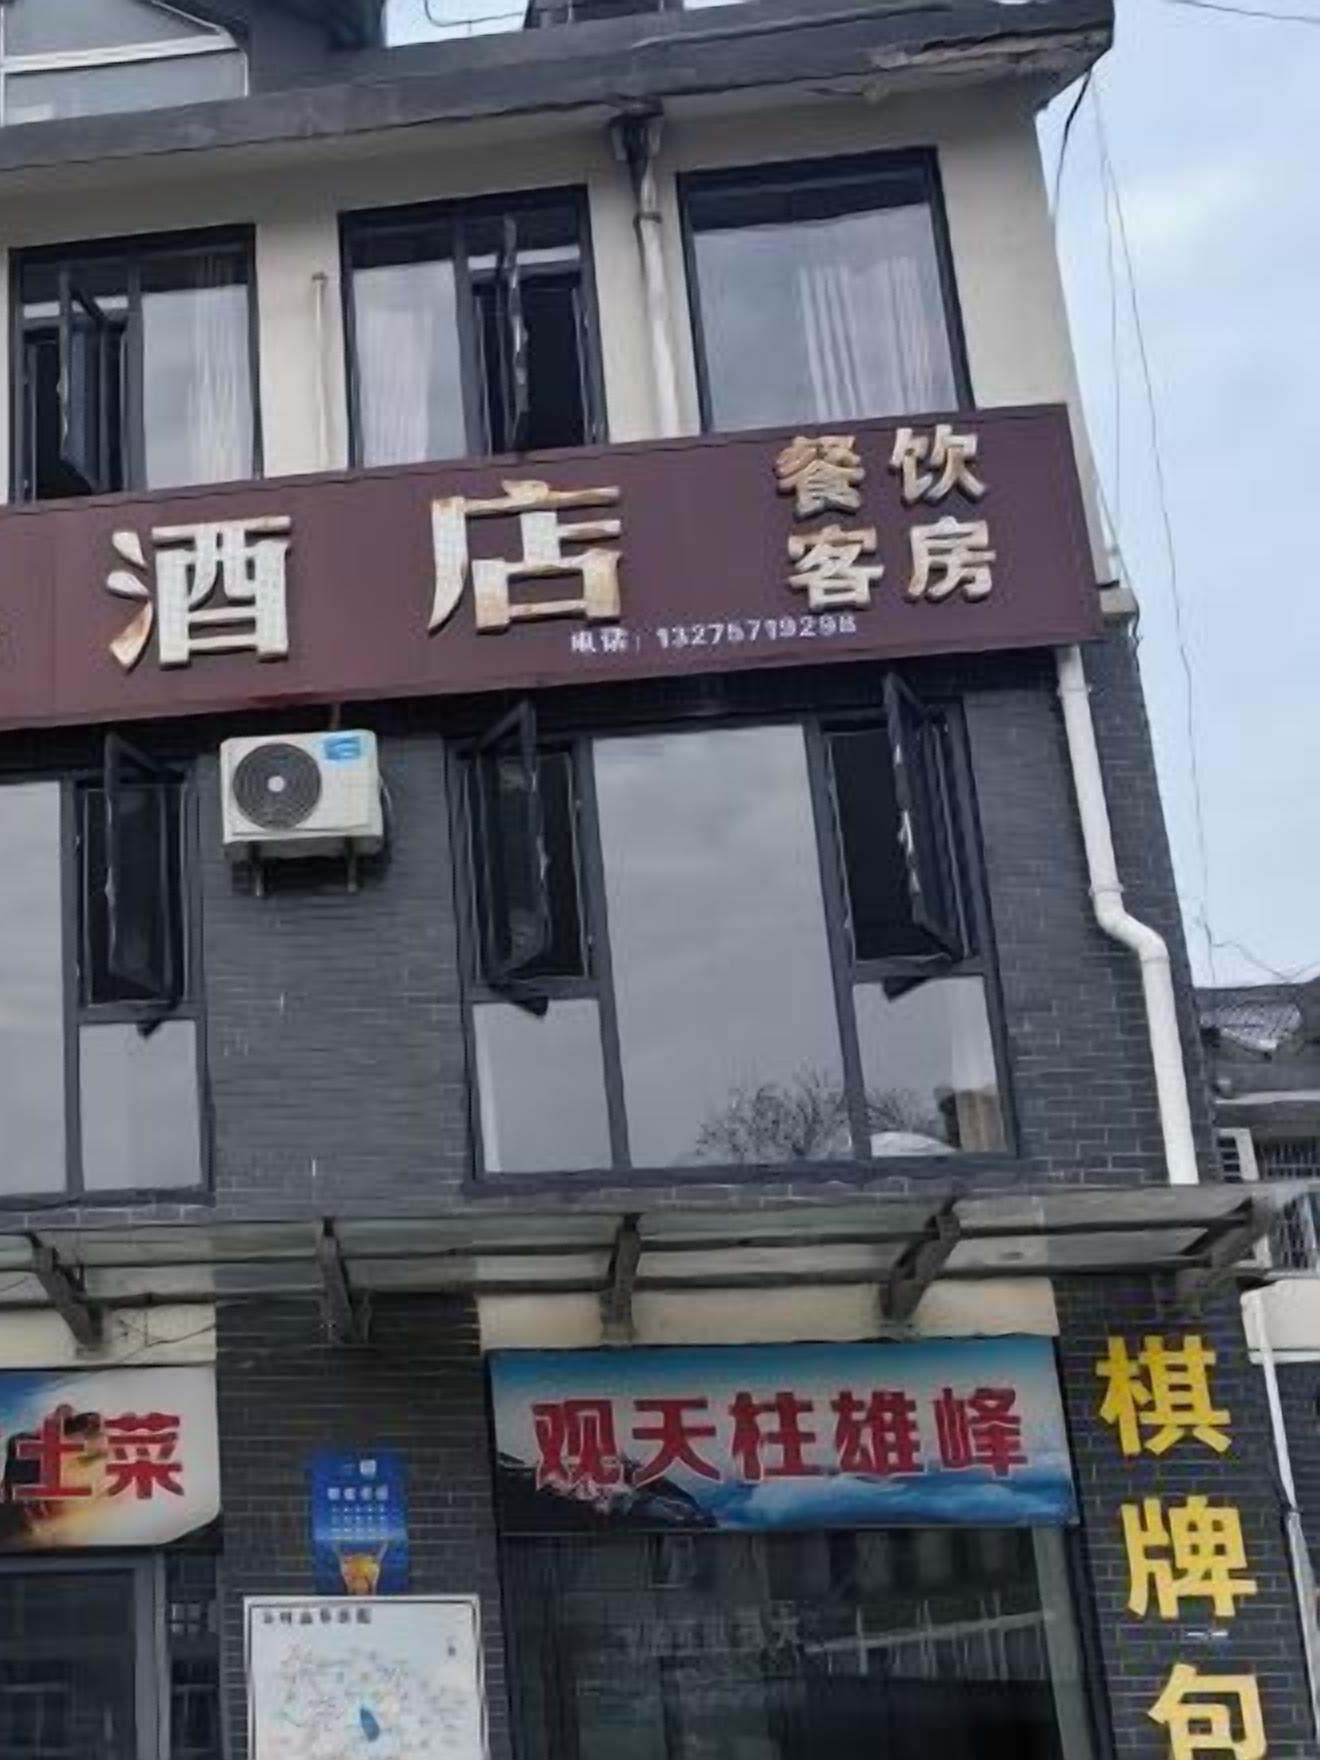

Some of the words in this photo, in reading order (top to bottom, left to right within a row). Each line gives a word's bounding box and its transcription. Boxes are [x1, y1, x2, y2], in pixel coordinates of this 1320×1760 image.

[774, 424, 988, 517] 餐饮
[787, 515, 996, 611] 客房
[532, 1385, 1027, 1488] 观天柱雄峰
[1096, 1335, 1268, 1760] 棋牌包
